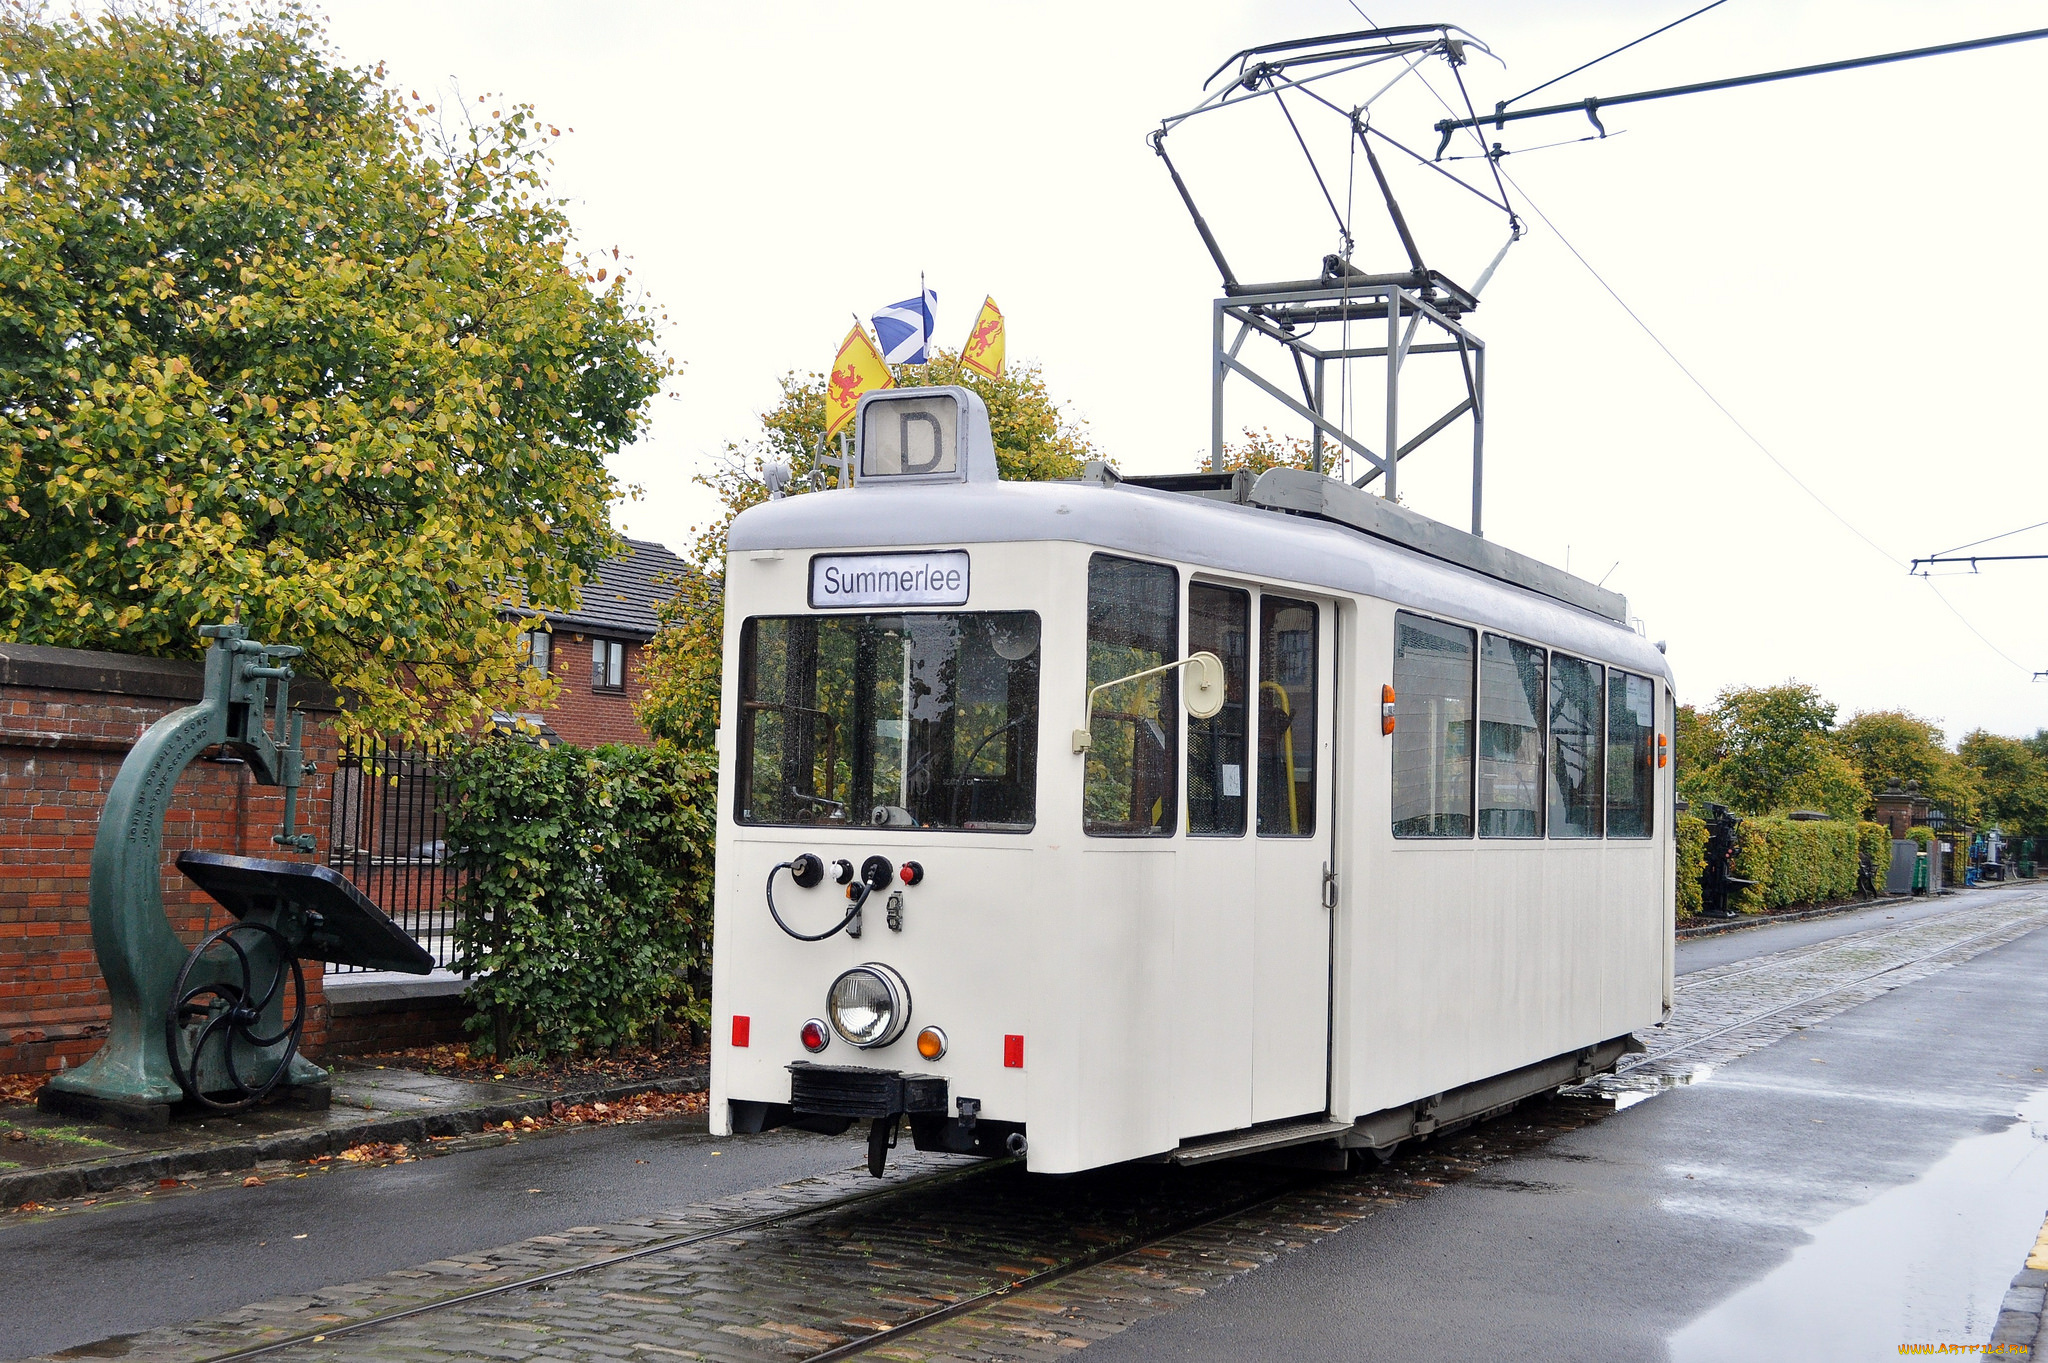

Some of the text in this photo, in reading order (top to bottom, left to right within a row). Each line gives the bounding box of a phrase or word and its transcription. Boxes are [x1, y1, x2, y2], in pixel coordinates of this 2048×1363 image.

[900, 411, 942, 472] D
[824, 564, 961, 594] Summerlee
[168, 729, 207, 772] SCOTLAND
[129, 810, 142, 843] JOHN
[184, 716, 208, 733] SONS
